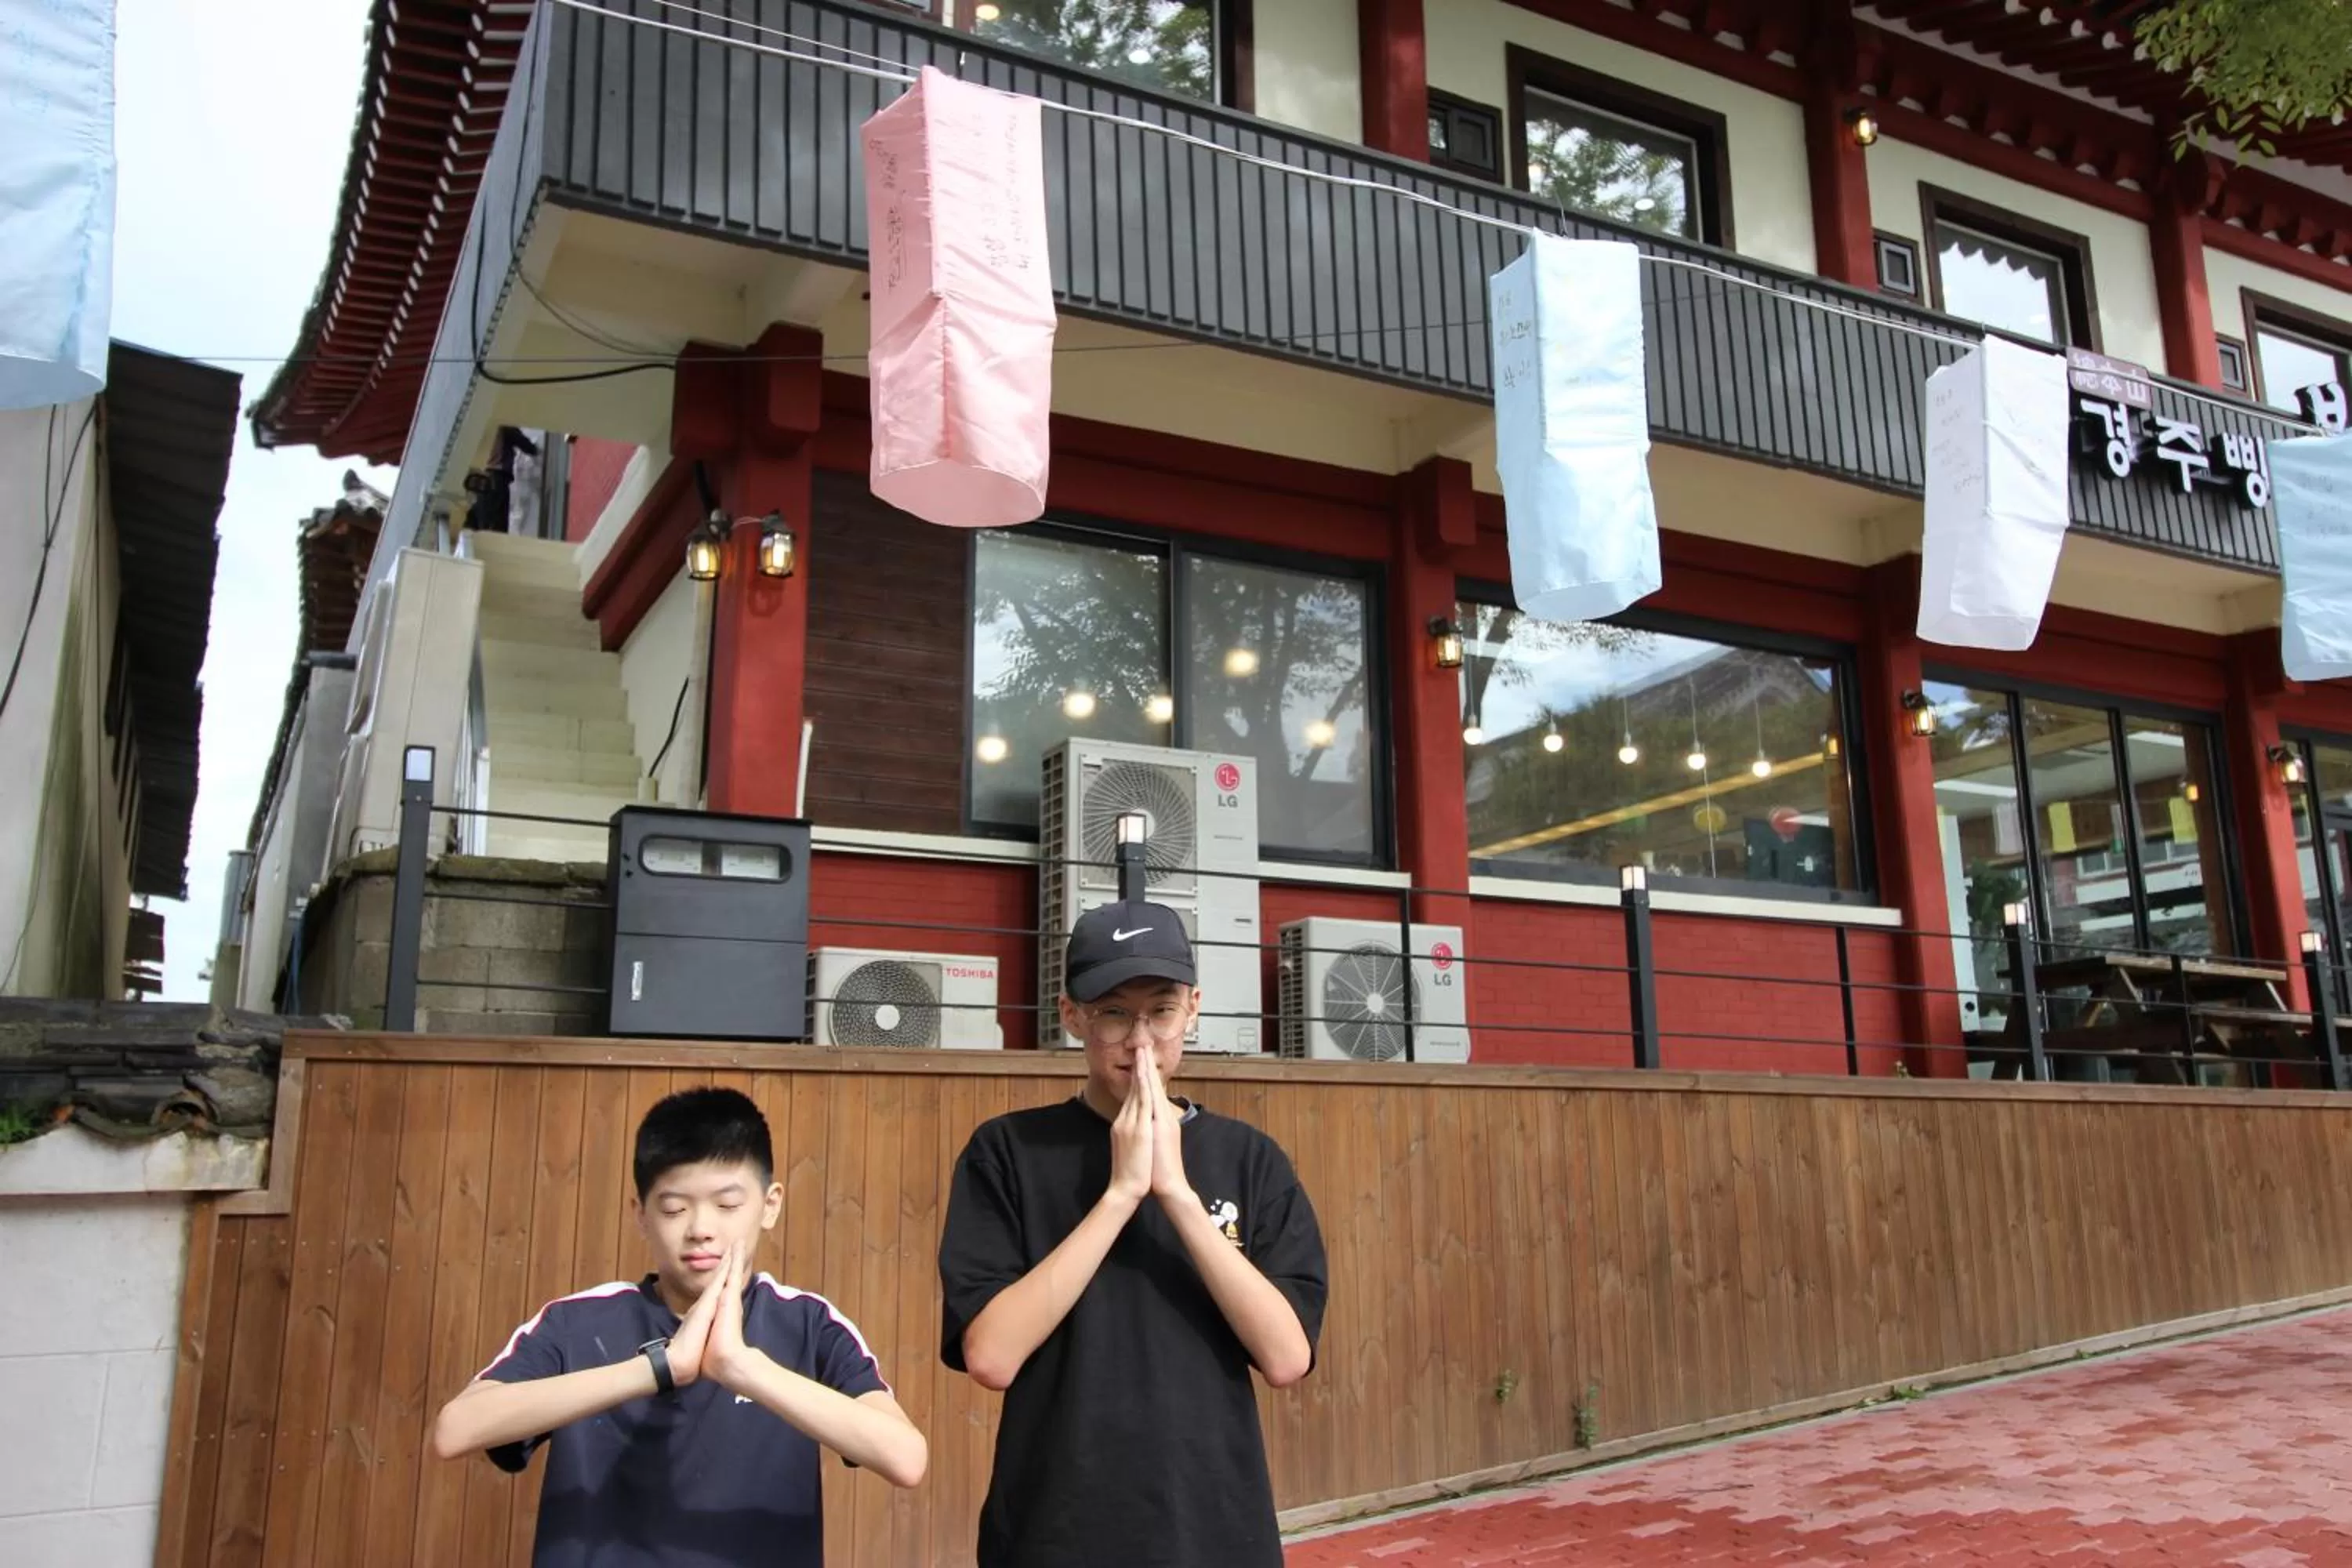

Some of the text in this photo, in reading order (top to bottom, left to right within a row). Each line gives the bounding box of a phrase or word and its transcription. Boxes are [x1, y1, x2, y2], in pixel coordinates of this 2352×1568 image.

[2081, 397, 2271, 508] 경주빵
[1218, 793, 1238, 808] LG
[946, 967, 993, 979] TOSHIBA
[1434, 973, 1452, 986] LG
